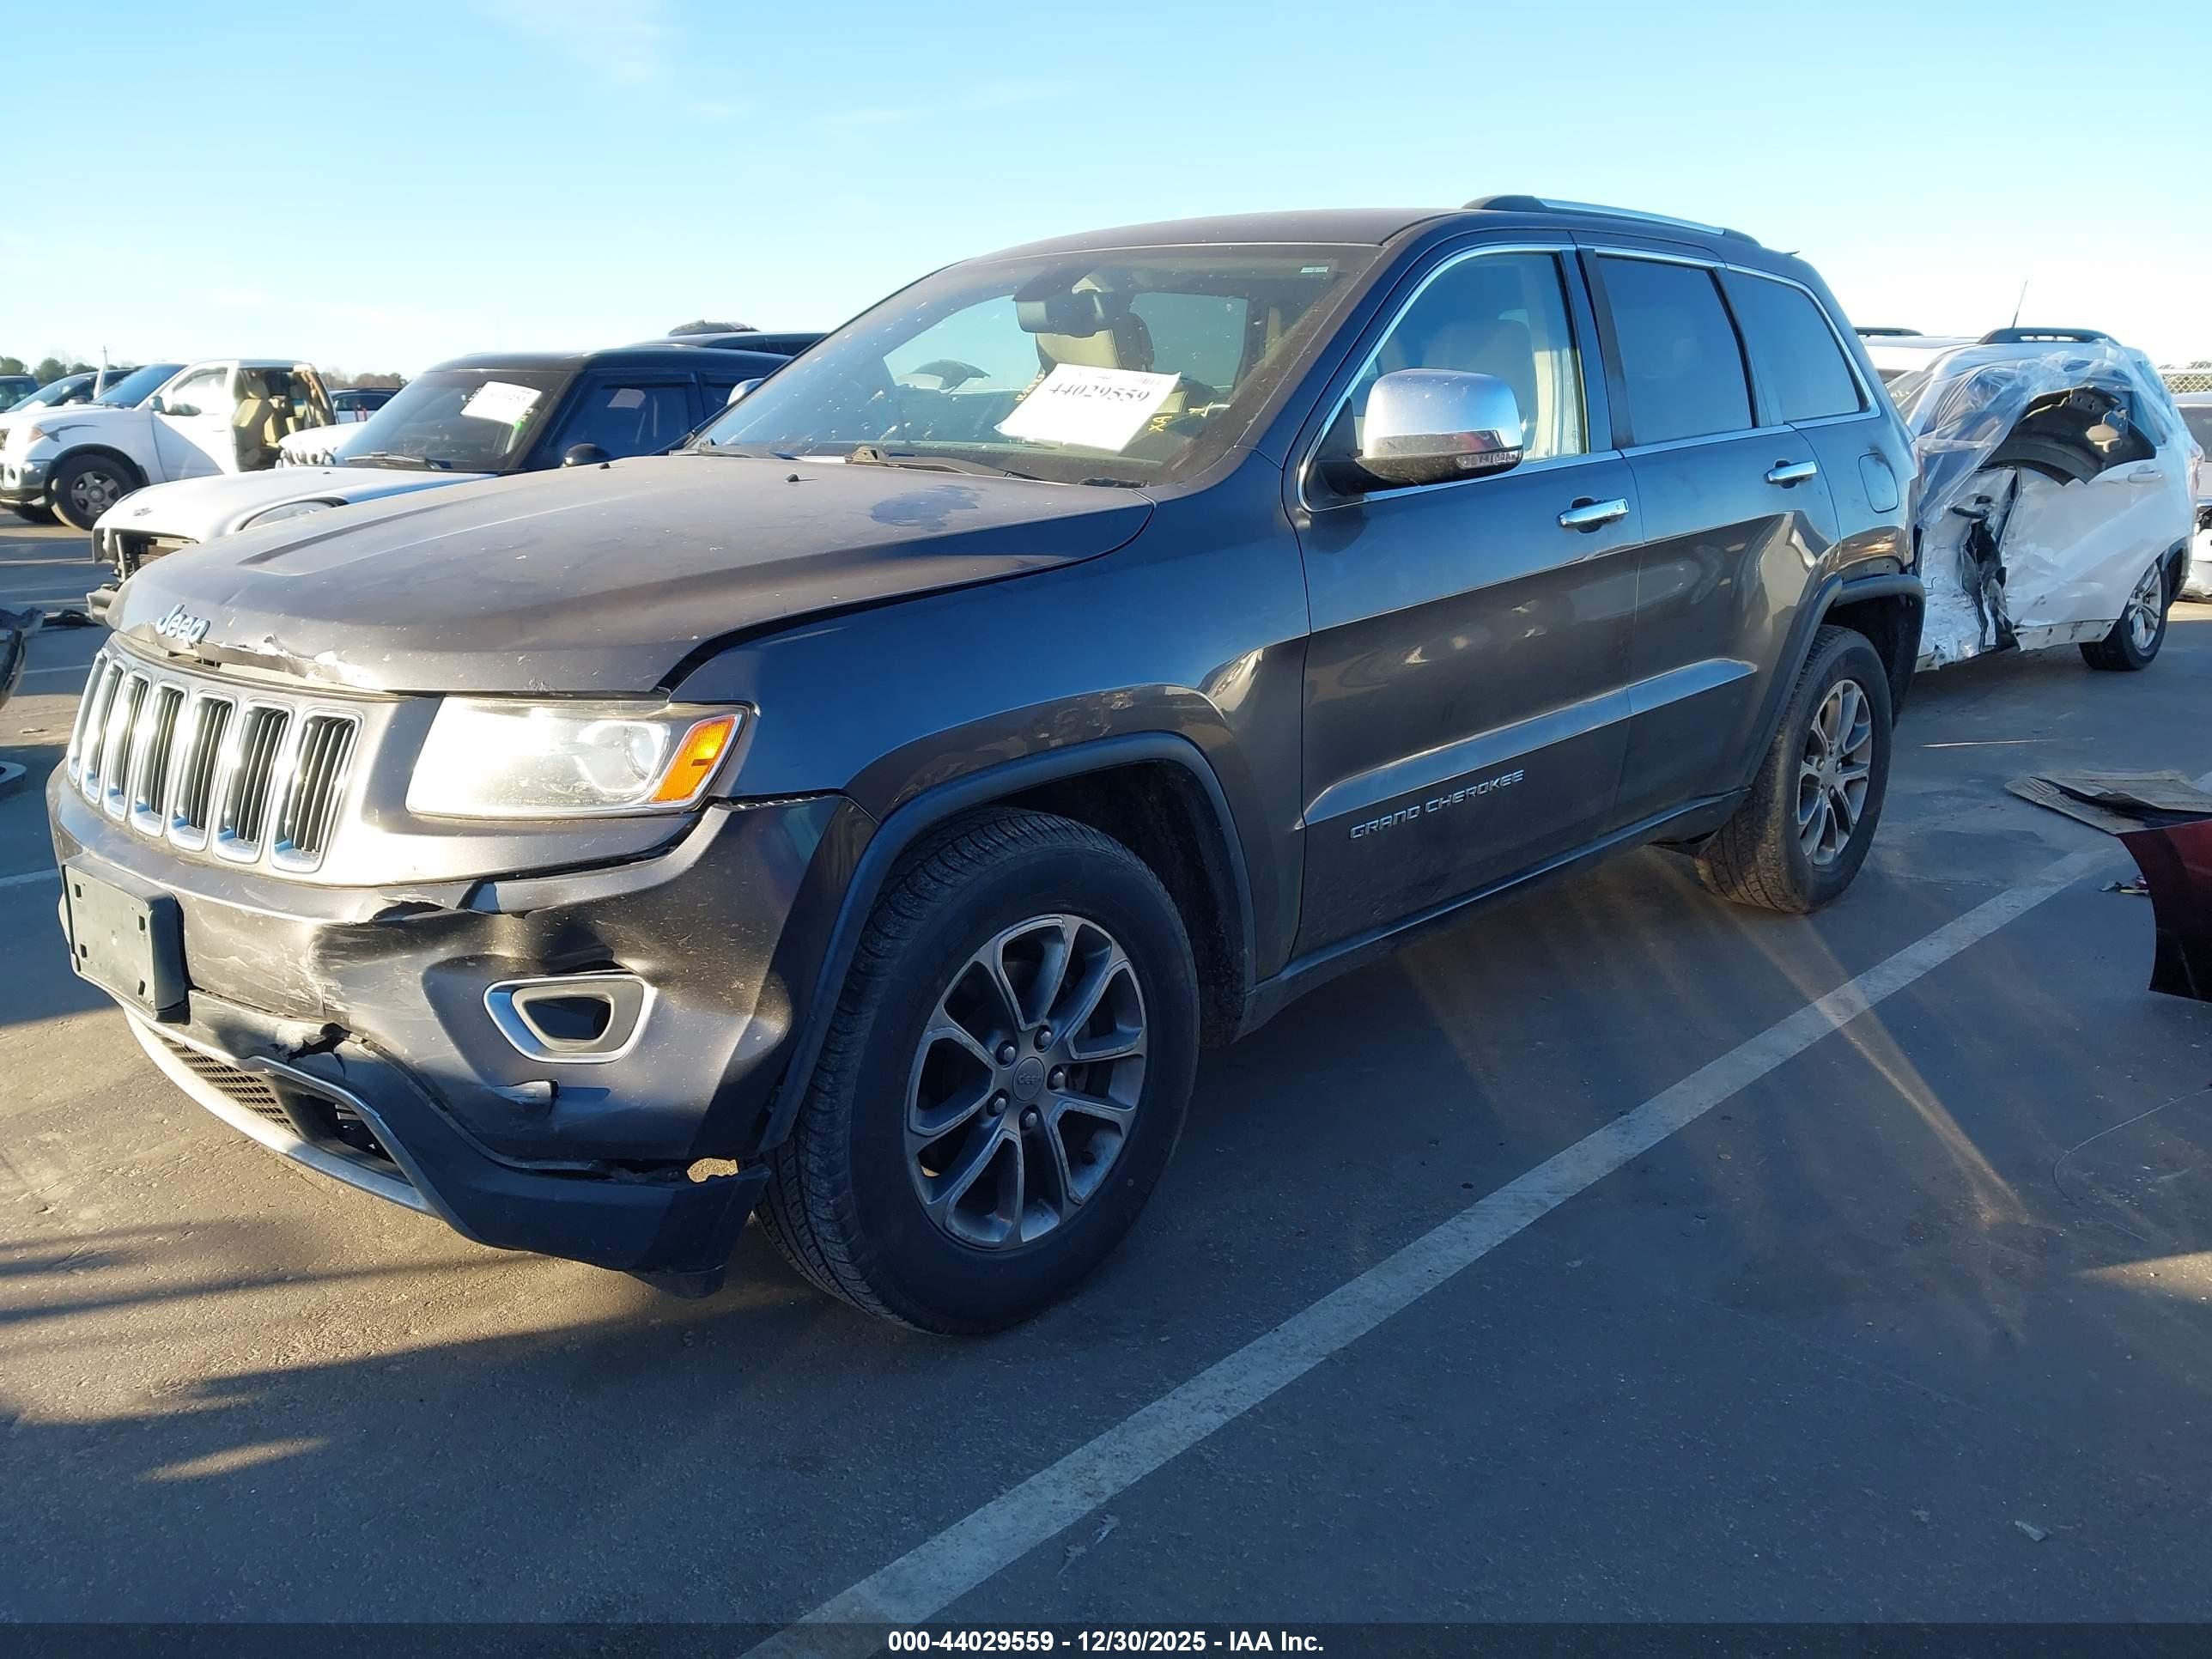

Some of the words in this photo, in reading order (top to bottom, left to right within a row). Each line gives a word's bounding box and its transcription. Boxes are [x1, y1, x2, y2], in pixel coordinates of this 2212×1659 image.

[1048, 383, 1152, 402] 44029559
[155, 604, 210, 649] Jeep
[1349, 805, 1421, 839] GRAND
[1425, 769, 1525, 813] CHEROKEE
